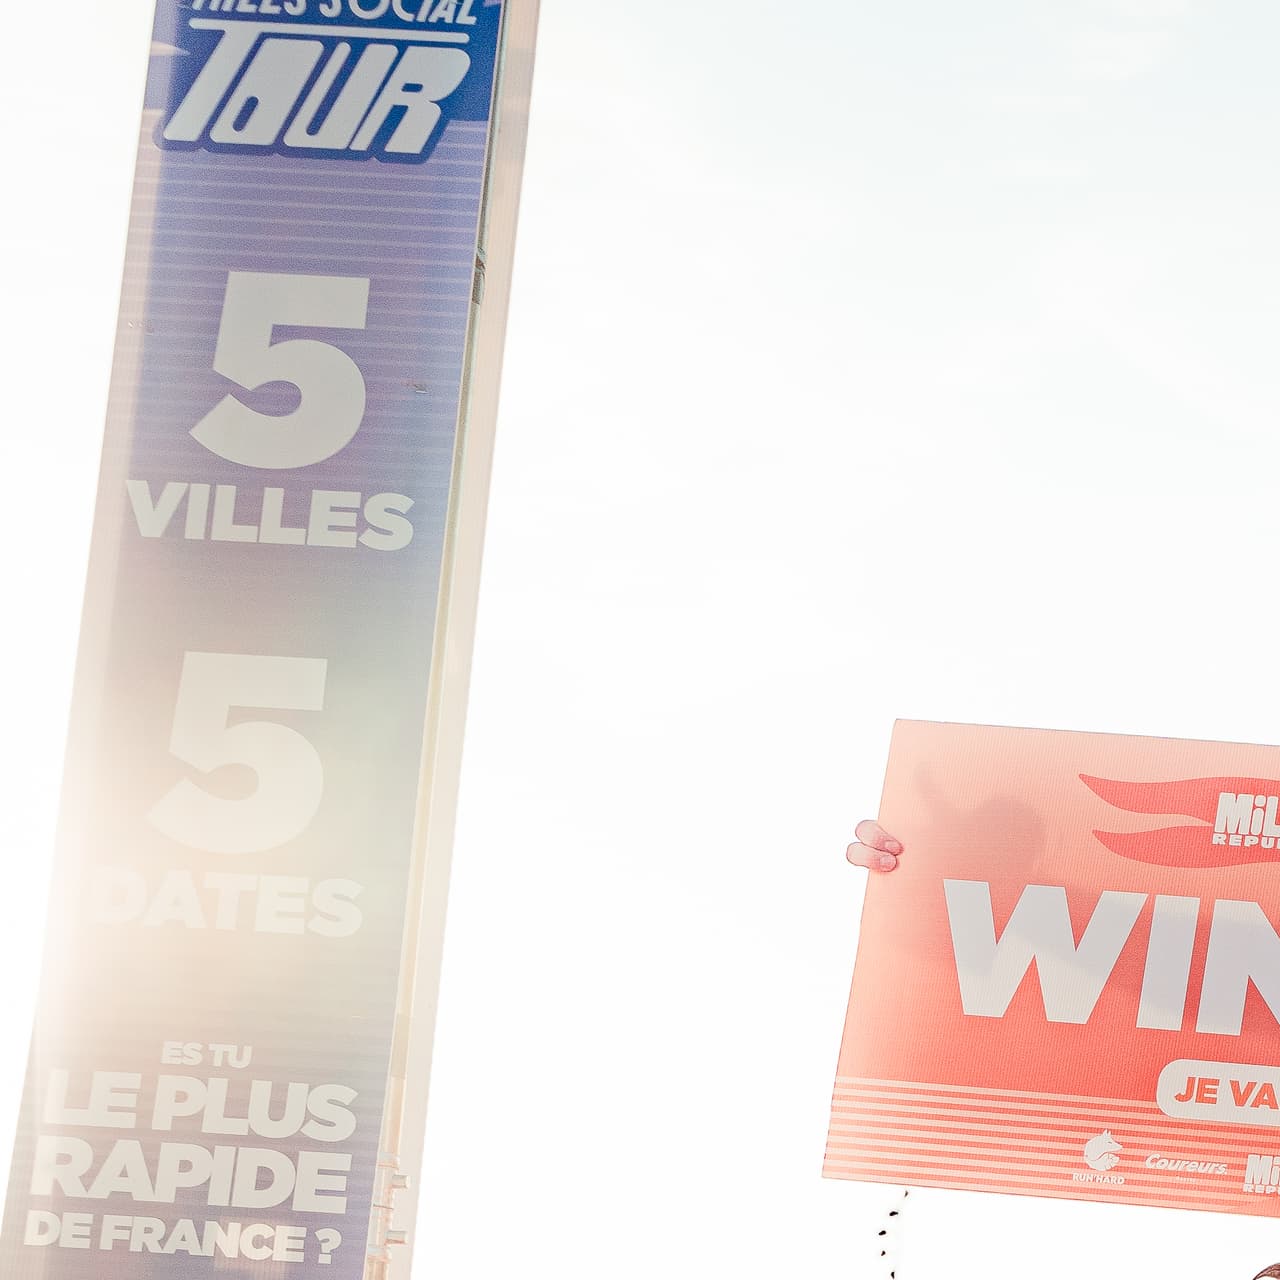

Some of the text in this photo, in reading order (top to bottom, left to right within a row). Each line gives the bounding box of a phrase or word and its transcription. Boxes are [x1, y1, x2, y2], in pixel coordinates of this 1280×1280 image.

[163, 17, 471, 155] TOUR
[188, 271, 370, 469] 5
[126, 479, 415, 551] VILLES
[145, 651, 328, 854] 5
[82, 864, 364, 937] DATES
[160, 1041, 252, 1069] ES TU
[1174, 1076, 1220, 1105] JE
[44, 1068, 359, 1143] LE PLUS
[30, 1135, 353, 1214] RAPIDE
[24, 1209, 342, 1265] DE FRANCE ?
